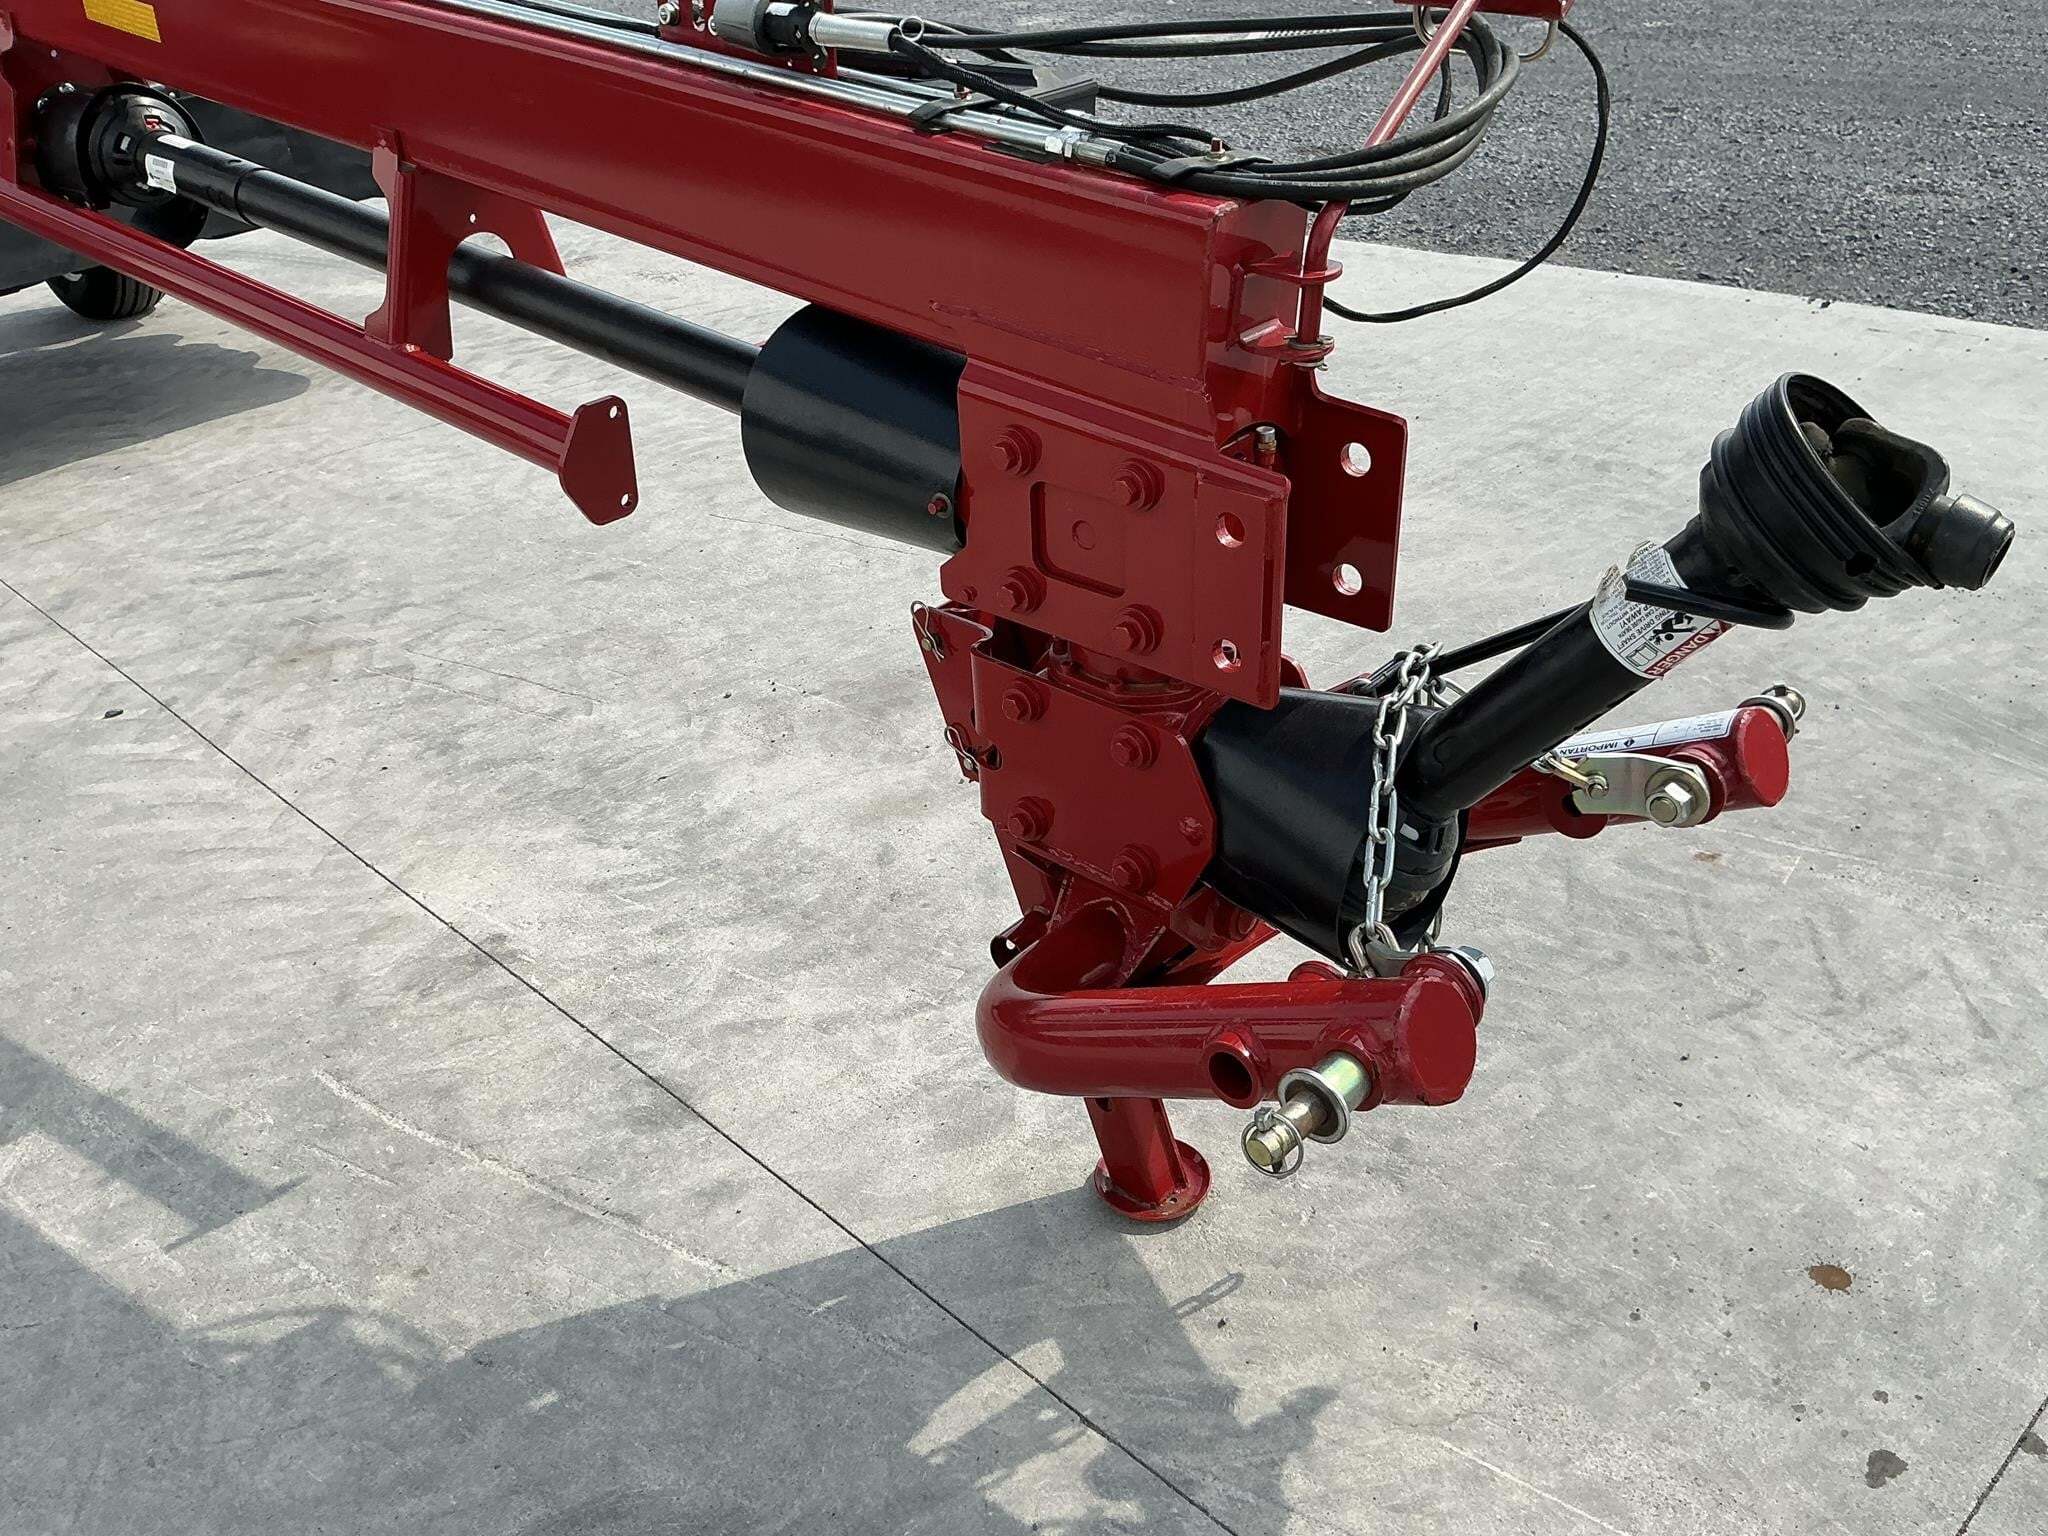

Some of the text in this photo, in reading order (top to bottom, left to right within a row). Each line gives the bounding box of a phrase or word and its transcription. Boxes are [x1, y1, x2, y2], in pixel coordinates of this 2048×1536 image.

[1618, 607, 1643, 629] AWAY!
[1635, 618, 1655, 635] DRIVE
[1617, 625, 1632, 638] DEATH
[1616, 632, 1637, 649] SHAFT
[1648, 635, 1708, 676] DANGER
[1560, 742, 1617, 755] IMPORTAN
